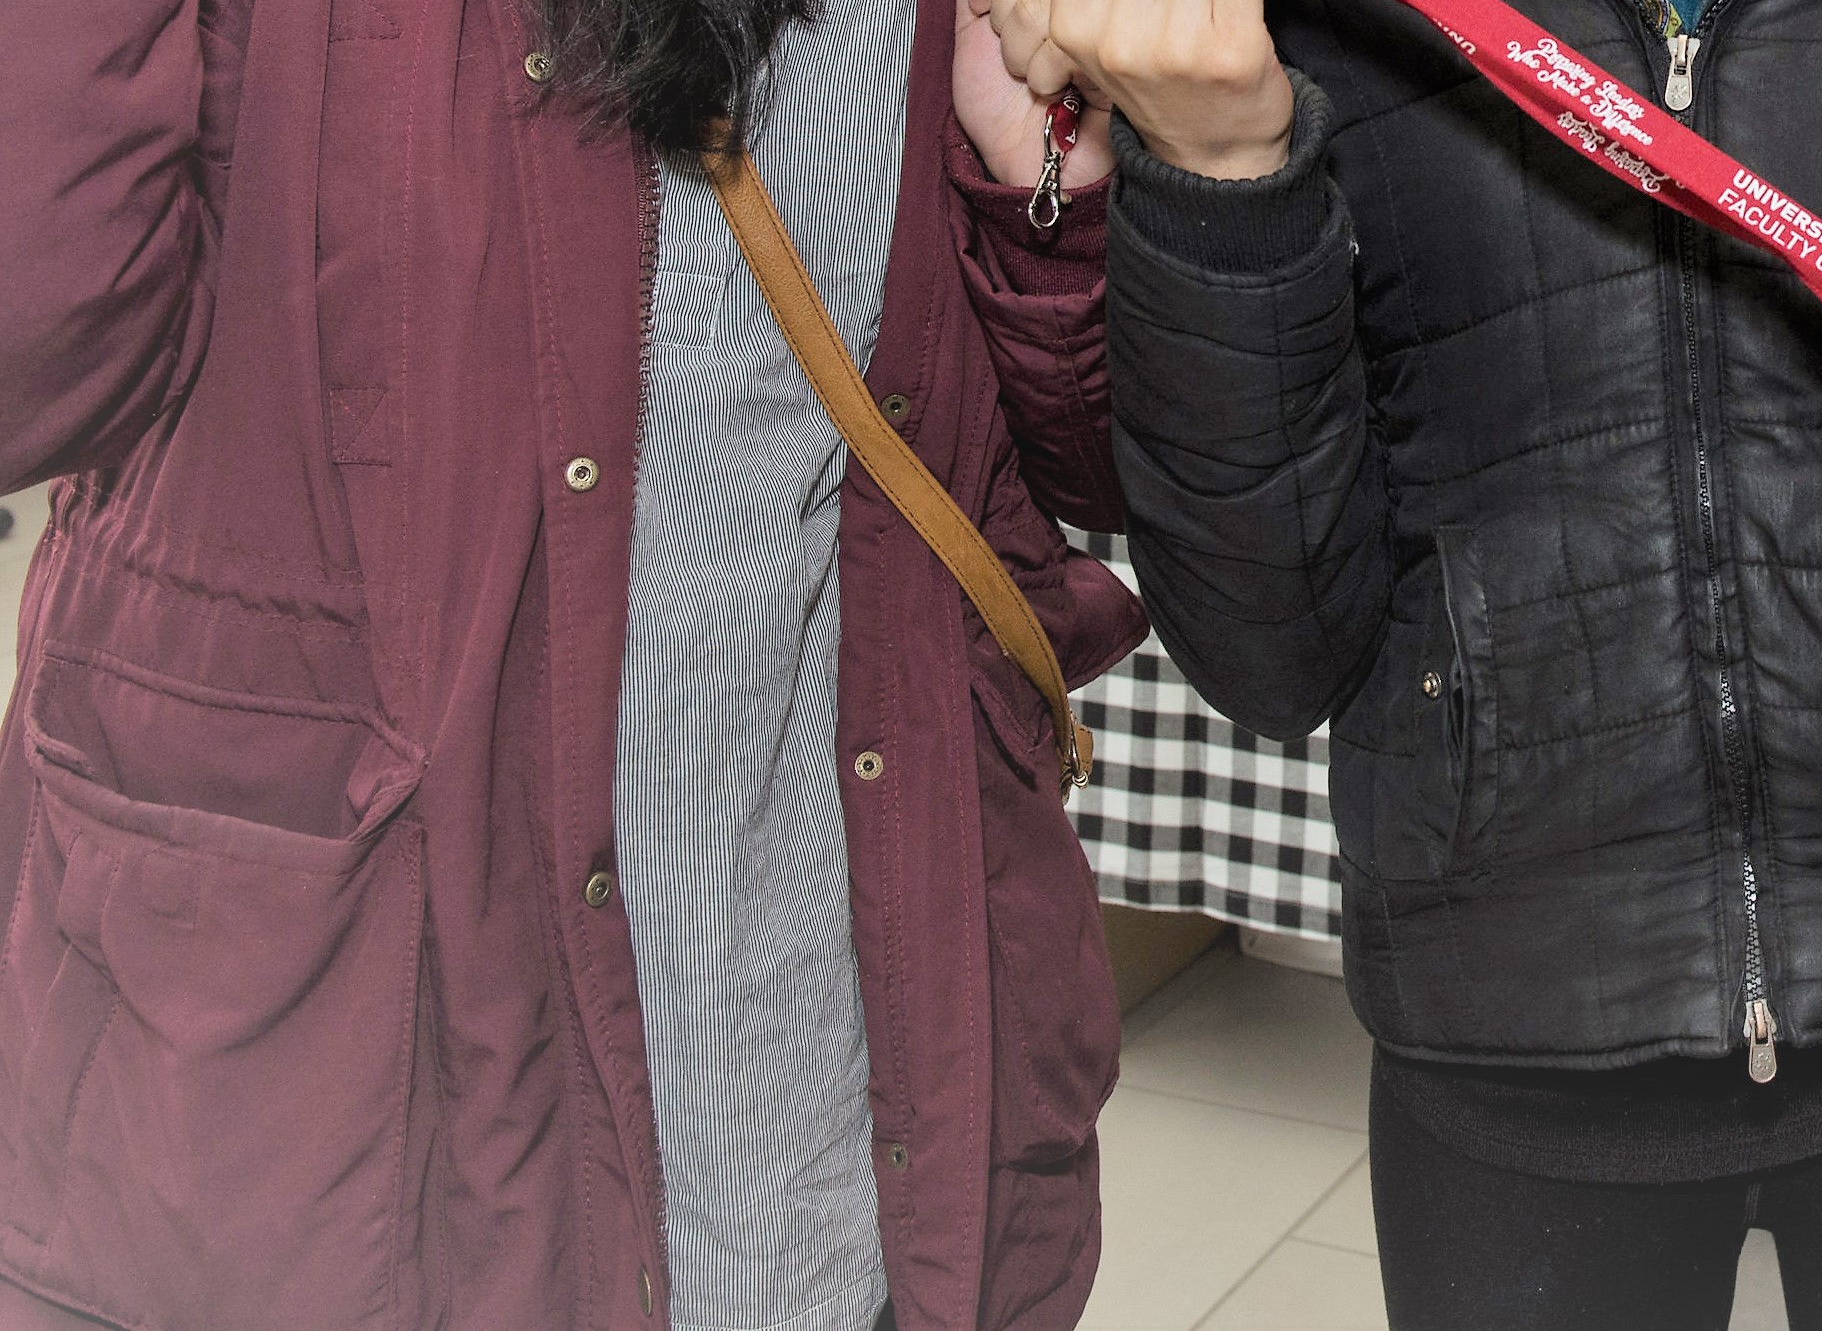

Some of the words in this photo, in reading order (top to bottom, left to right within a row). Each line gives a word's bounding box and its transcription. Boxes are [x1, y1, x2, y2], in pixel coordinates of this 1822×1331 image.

[1506, 41, 1541, 69] Who
[1537, 70, 1581, 97] Make
[1580, 94, 1592, 105] a
[1717, 187, 1817, 259] FACULTY
